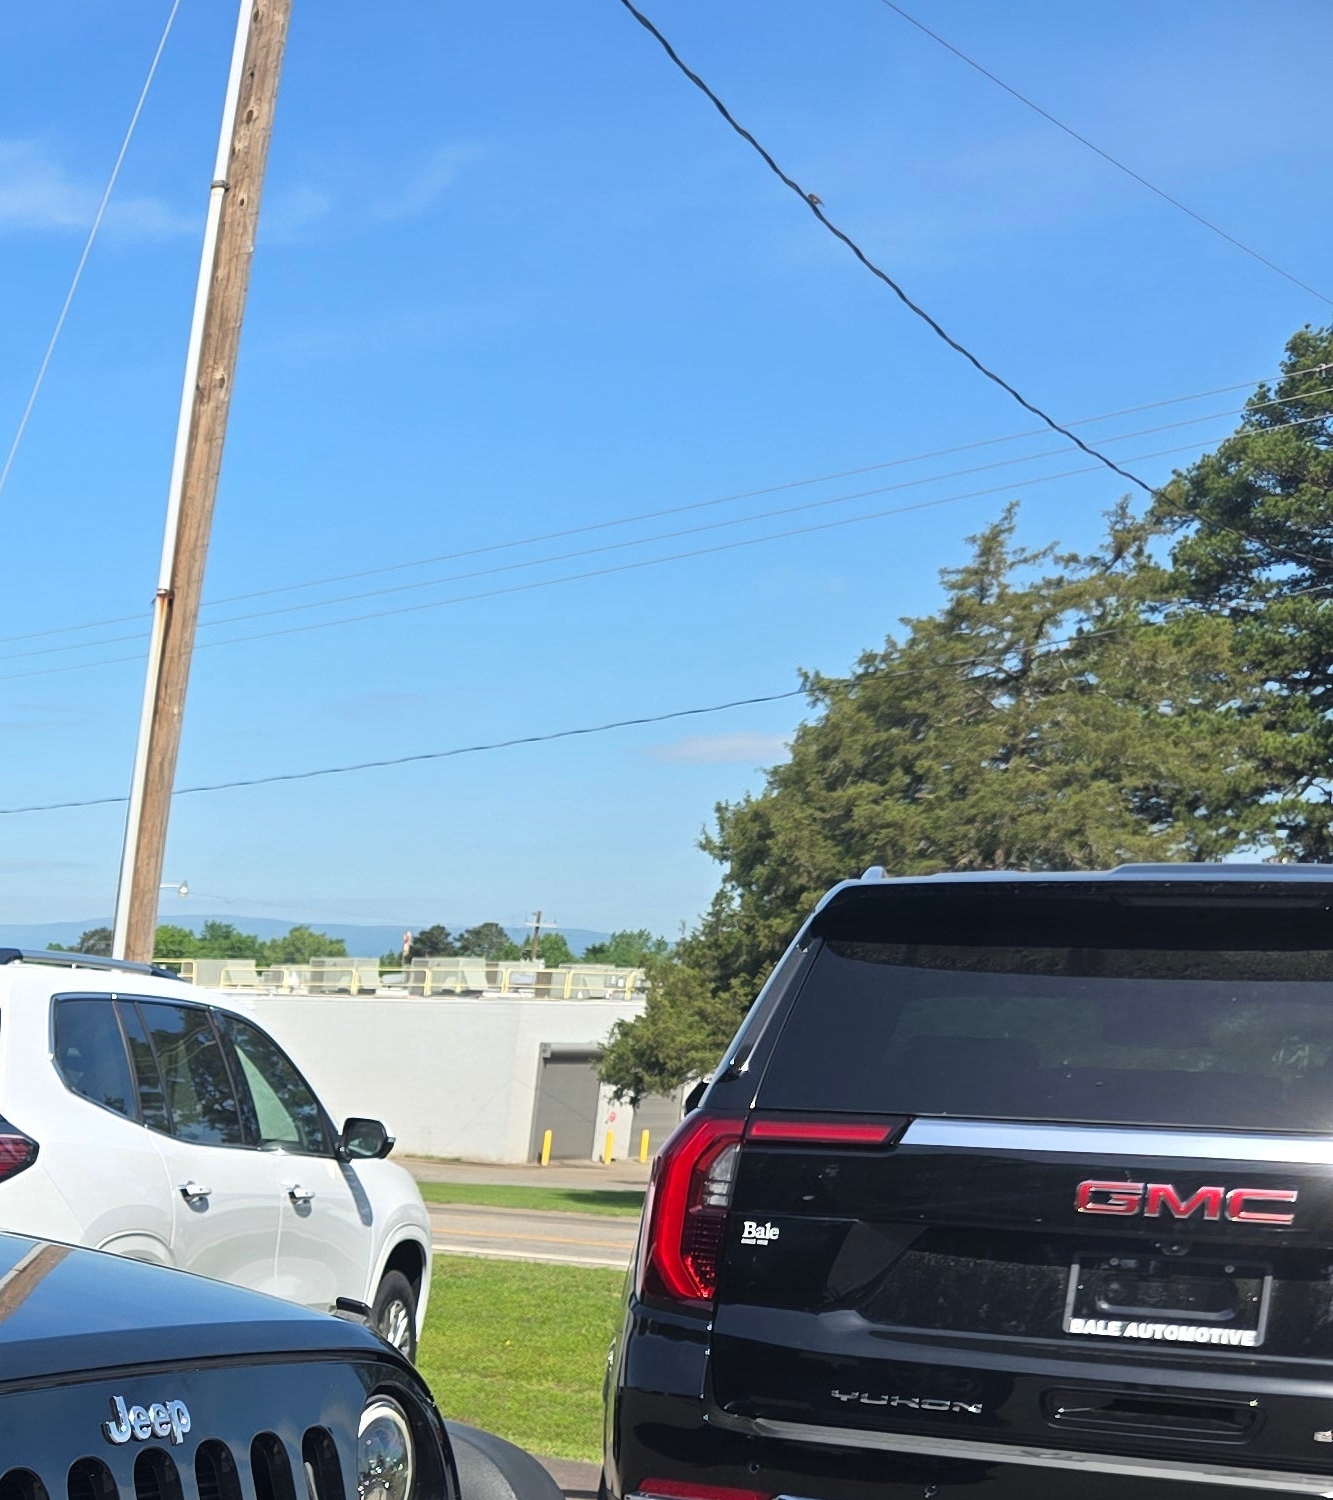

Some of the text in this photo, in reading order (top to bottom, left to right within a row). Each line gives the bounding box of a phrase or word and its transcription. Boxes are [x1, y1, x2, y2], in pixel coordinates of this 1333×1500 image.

[1074, 1179, 1299, 1226] GMC
[742, 1220, 780, 1241] Bale
[1069, 1317, 1257, 1347] BALE AUTOMOTIVE
[831, 1389, 983, 1414] YUKON
[102, 1395, 192, 1446] Jeep
